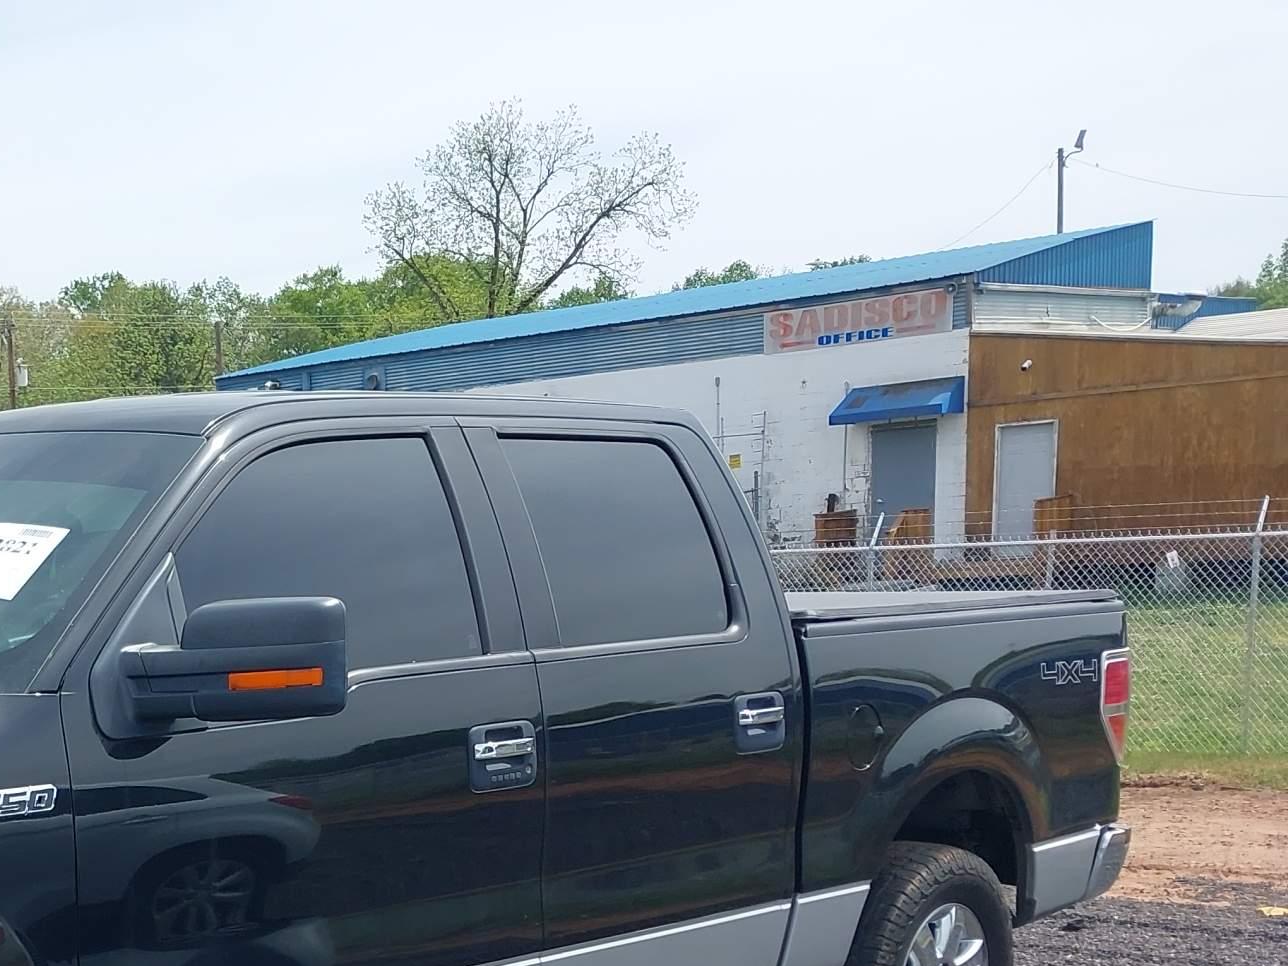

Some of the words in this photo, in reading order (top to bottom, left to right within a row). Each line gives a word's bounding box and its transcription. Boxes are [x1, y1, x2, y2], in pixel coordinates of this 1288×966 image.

[770, 293, 947, 340] SADISCO
[817, 326, 895, 347] OFFICE
[1041, 659, 1098, 685] 4X4
